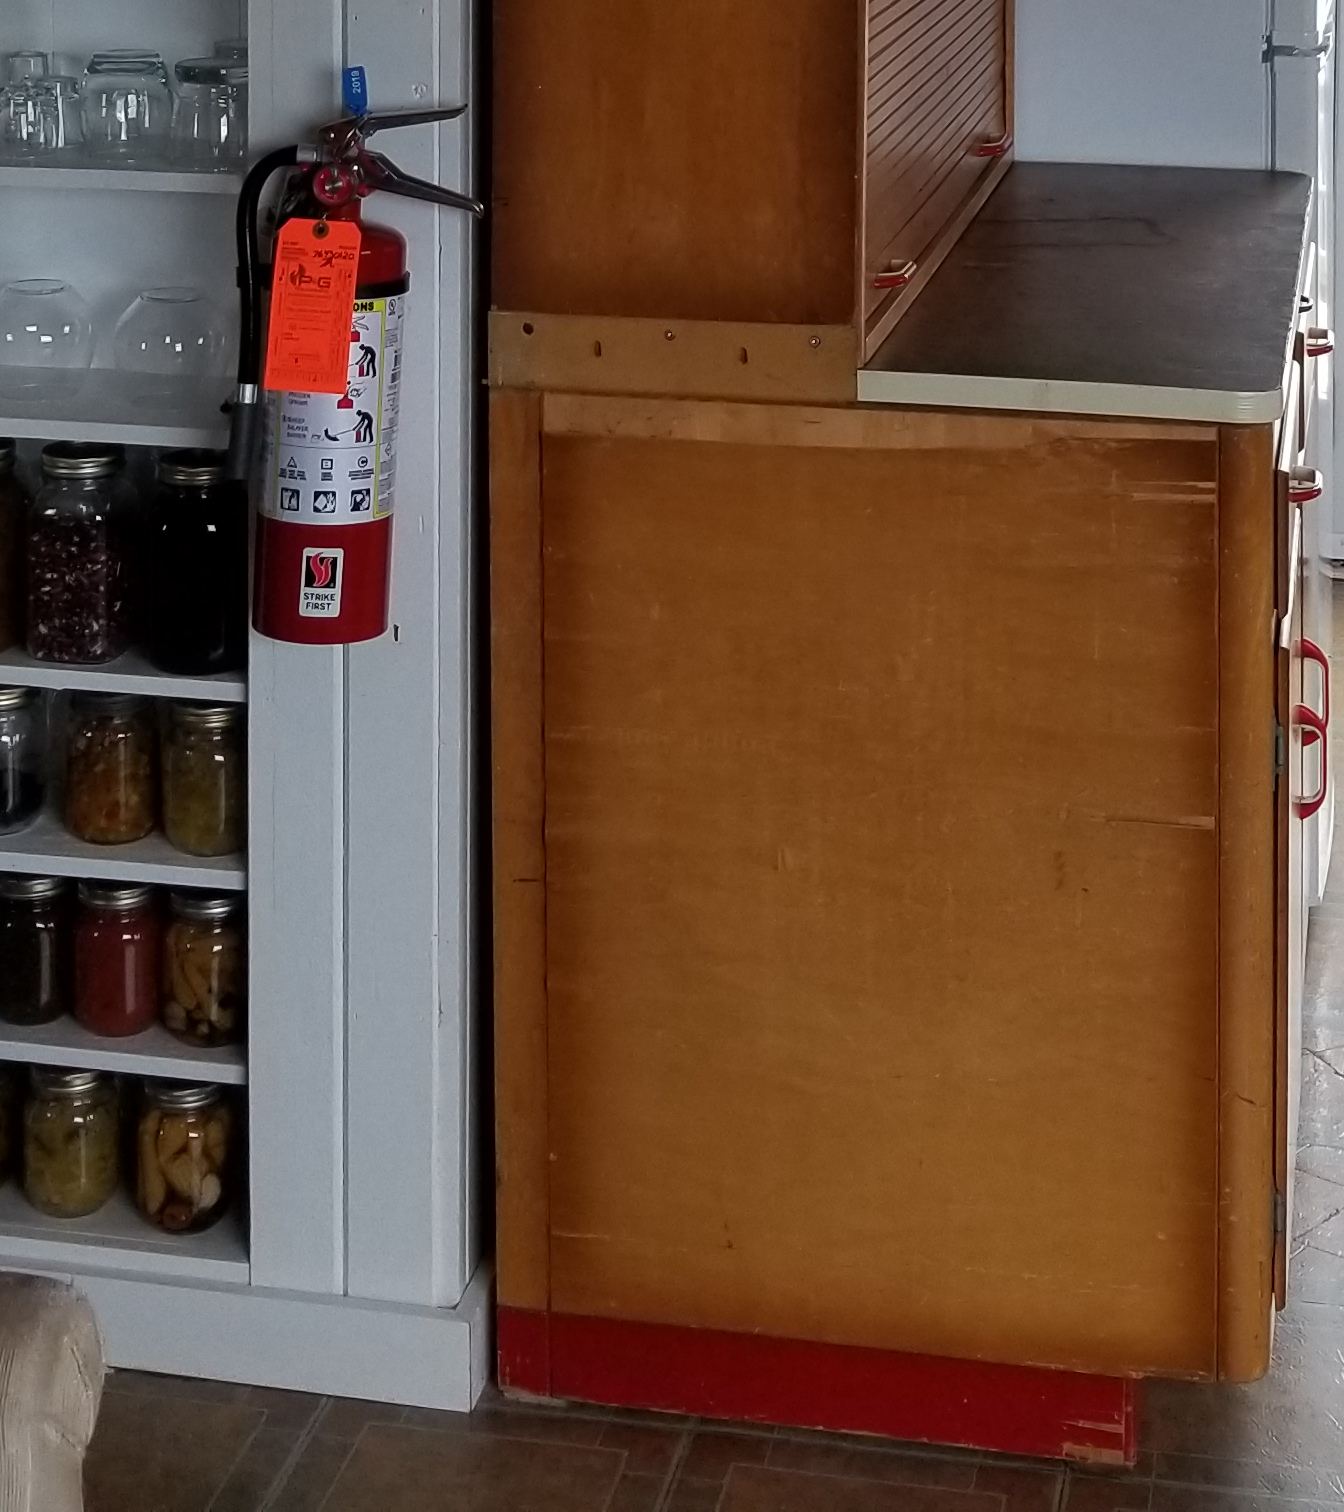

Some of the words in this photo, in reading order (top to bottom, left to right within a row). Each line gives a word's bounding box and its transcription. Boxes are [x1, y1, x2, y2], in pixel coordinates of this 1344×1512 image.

[353, 301, 375, 312] ONS
[303, 592, 336, 602] STRIKE
[305, 601, 332, 611] FIRST
